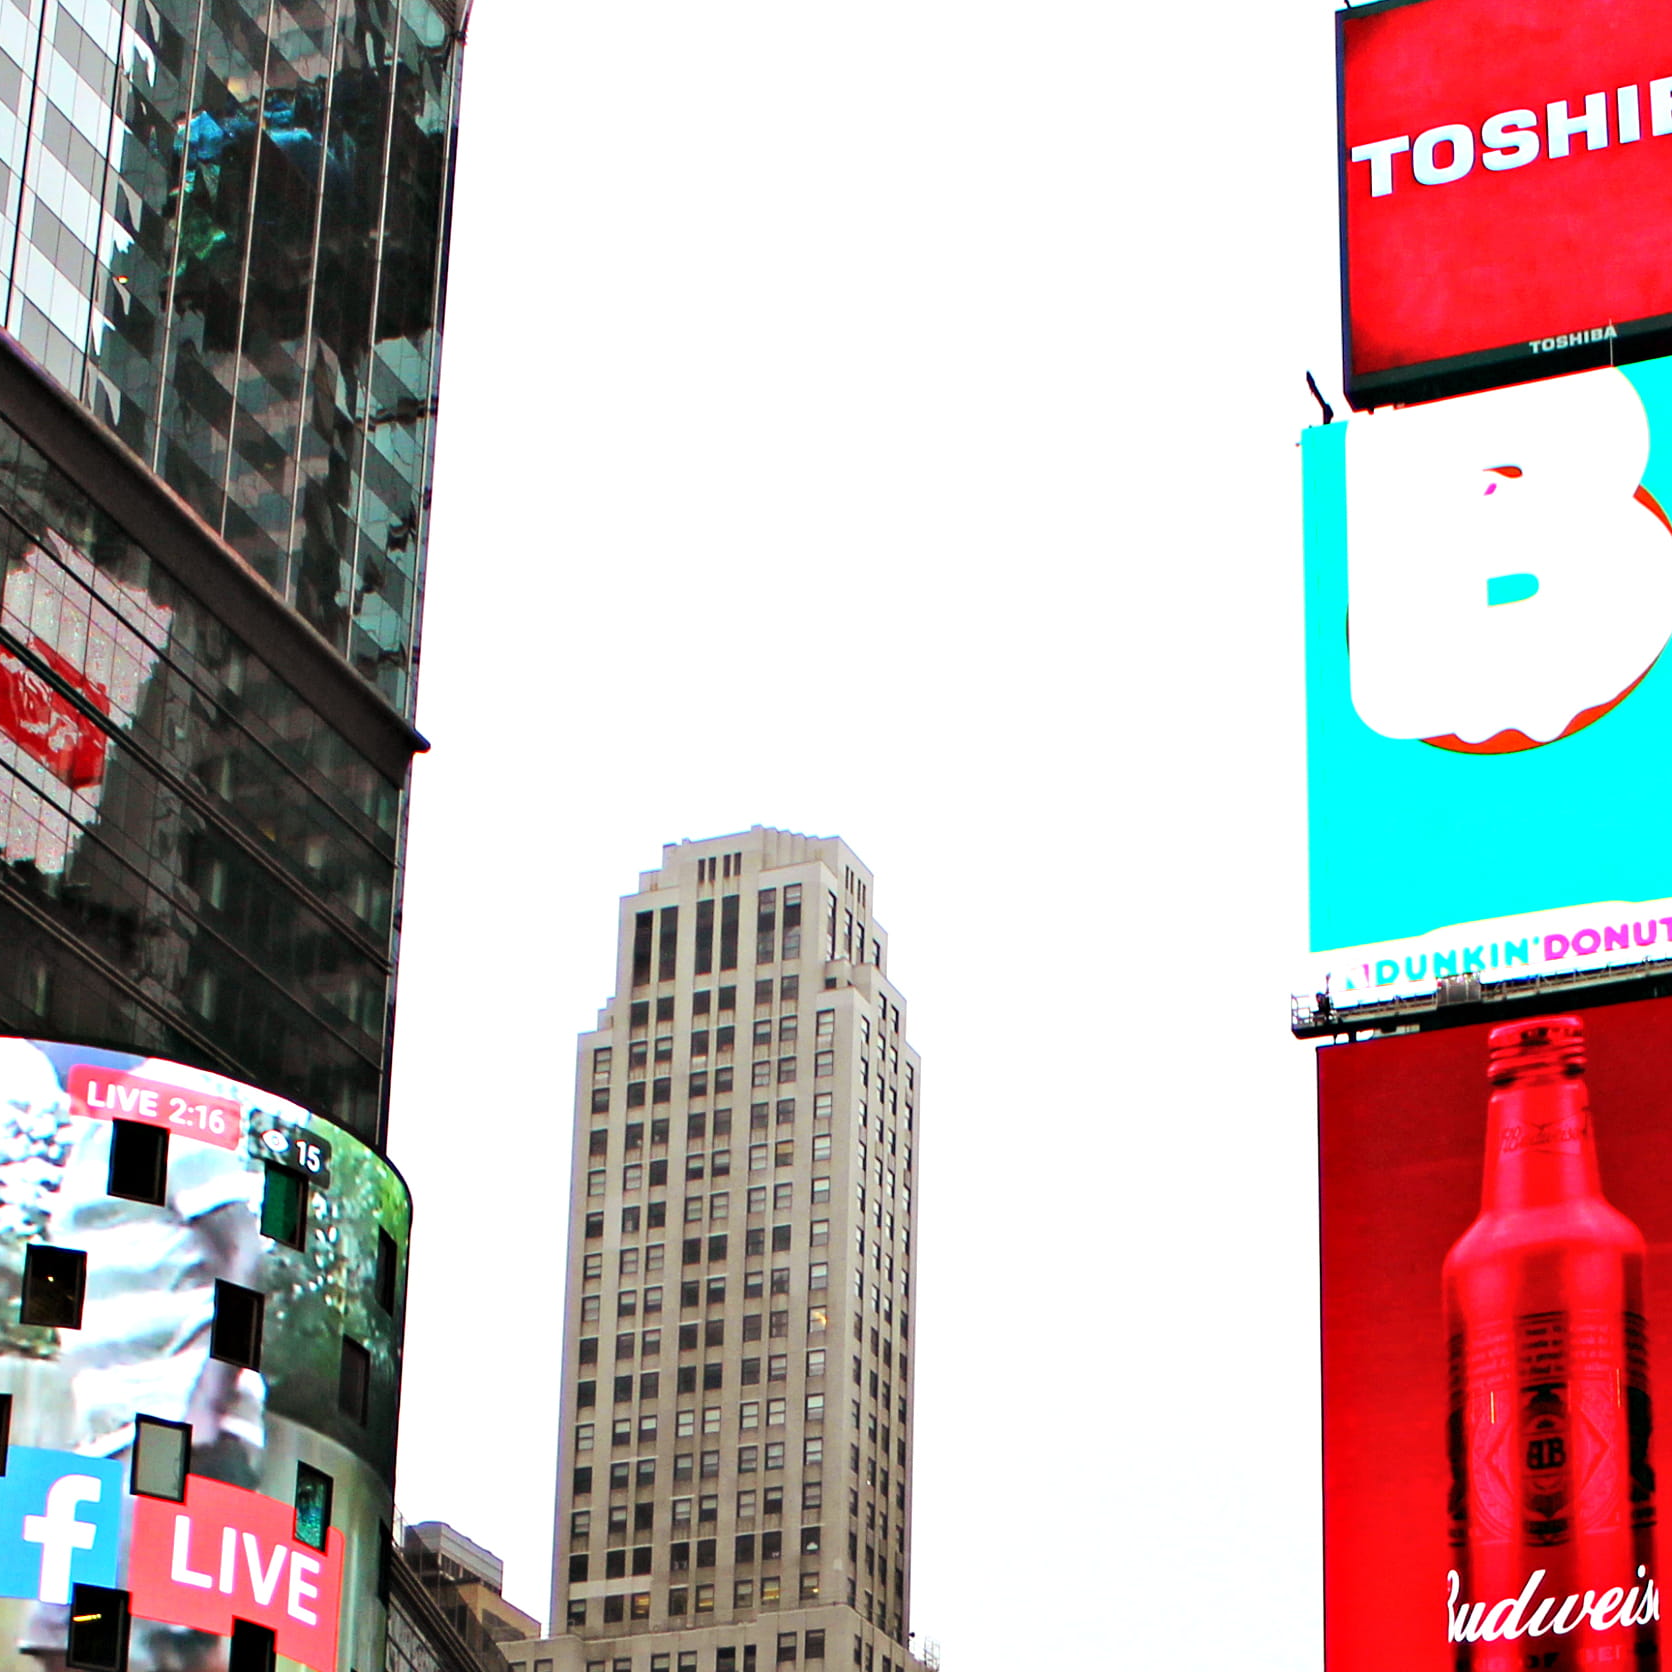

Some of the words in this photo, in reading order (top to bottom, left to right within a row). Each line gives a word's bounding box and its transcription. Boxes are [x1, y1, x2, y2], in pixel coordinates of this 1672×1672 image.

[1528, 325, 1618, 355] TOSHIBA
[1375, 934, 1541, 984] DUNKIN'
[87, 1081, 158, 1119] LIVE
[168, 1098, 225, 1135] 2:16
[295, 1139, 322, 1173] 15
[171, 1513, 321, 1628] LIVE
